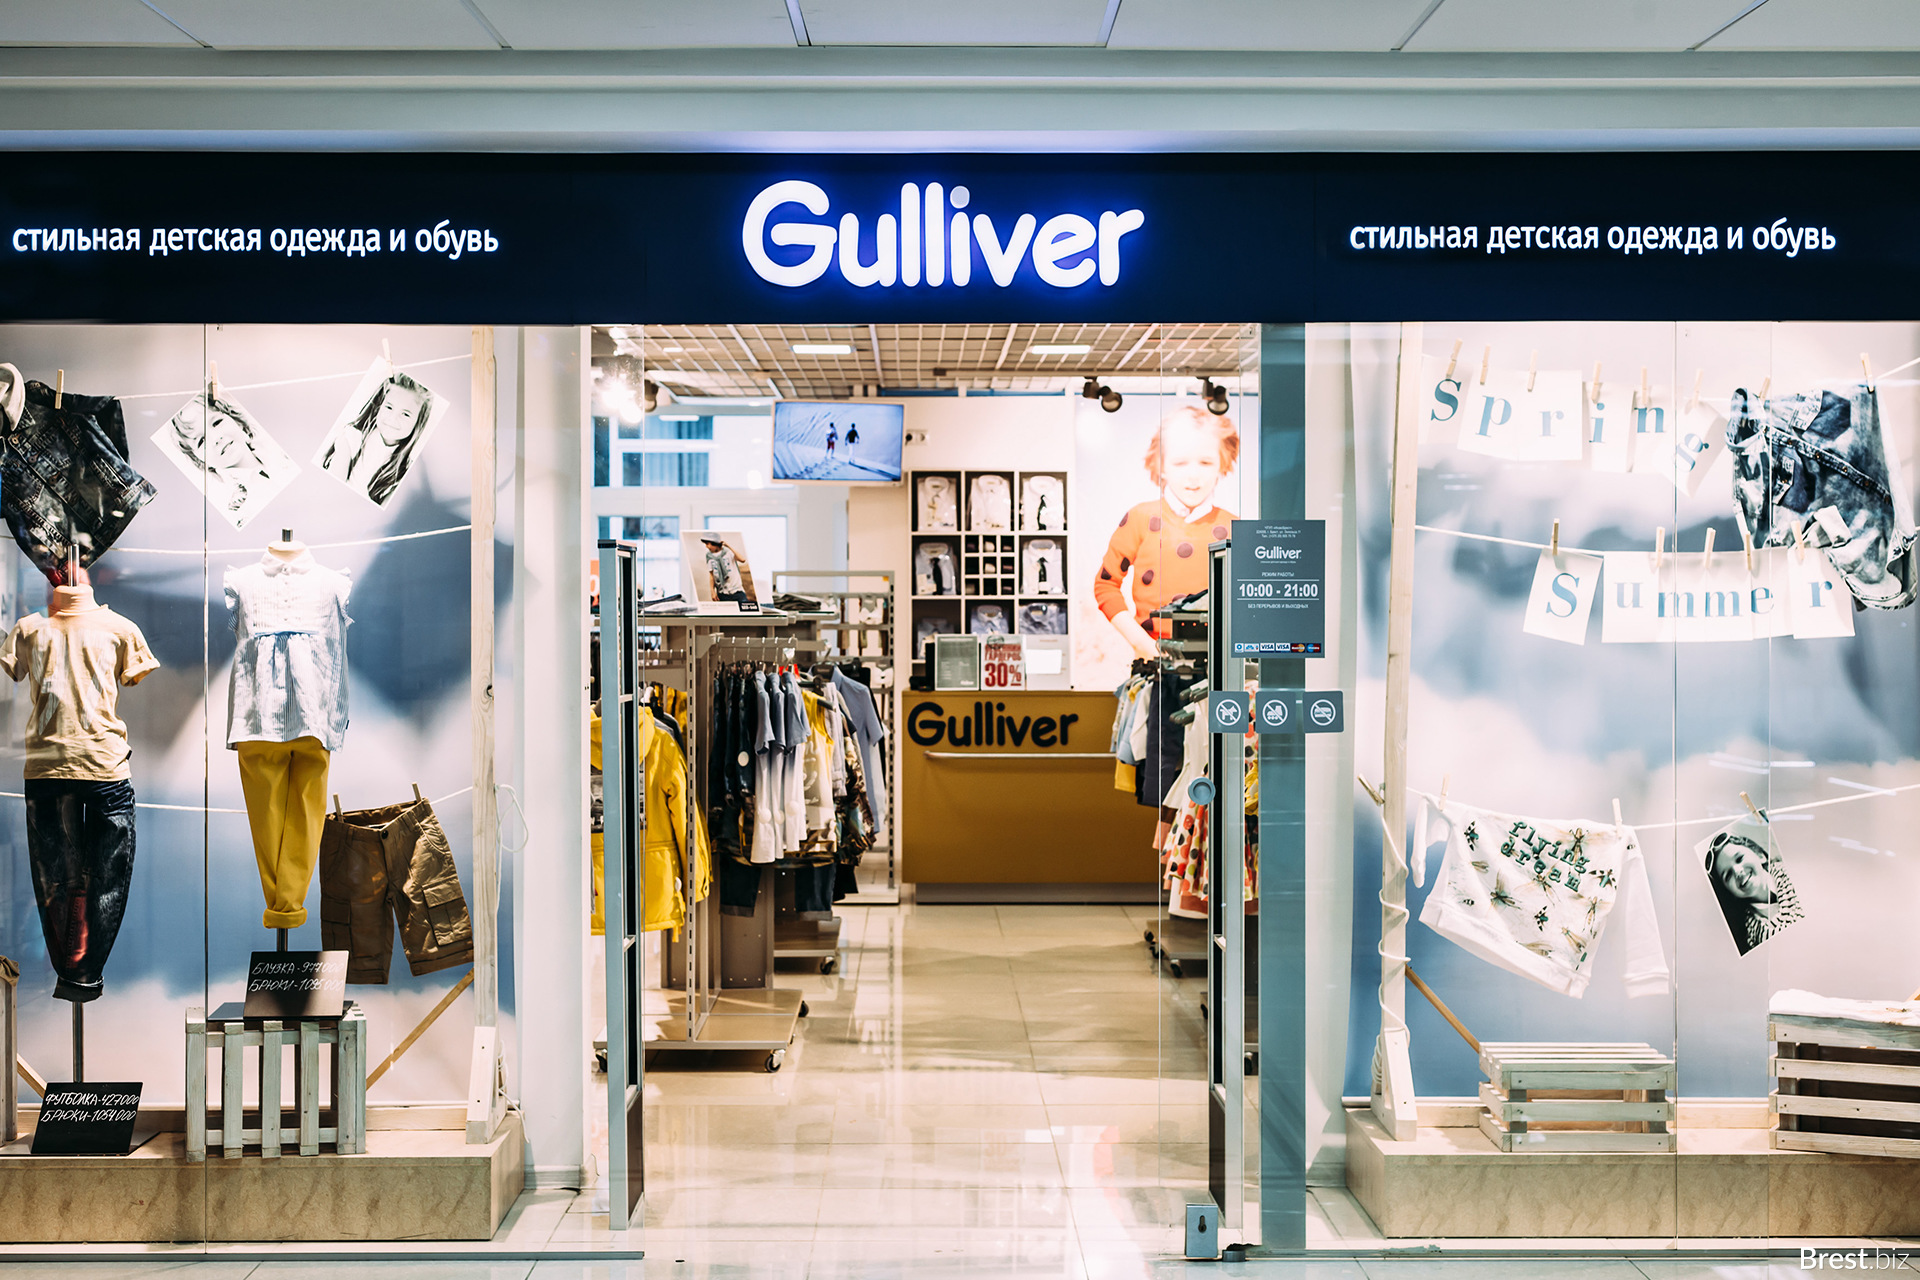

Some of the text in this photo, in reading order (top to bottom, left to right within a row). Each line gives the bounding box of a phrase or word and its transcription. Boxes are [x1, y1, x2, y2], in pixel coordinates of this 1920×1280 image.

[12, 219, 499, 260] стильная детская одежда и обувь
[742, 179, 1145, 287] Gulliver
[1349, 216, 1836, 258] стильная детская одежда и обувь
[1430, 378, 1709, 472] Spring
[1254, 545, 1302, 560] Gulliver
[1239, 583, 1273, 597] 10:00
[1284, 583, 1318, 597] 21:00
[1546, 573, 1833, 618] Summer
[984, 662, 1022, 687] 30%
[908, 701, 1079, 747] Gulliver
[1500, 836, 1582, 892] dream
[1508, 821, 1591, 874] flying
